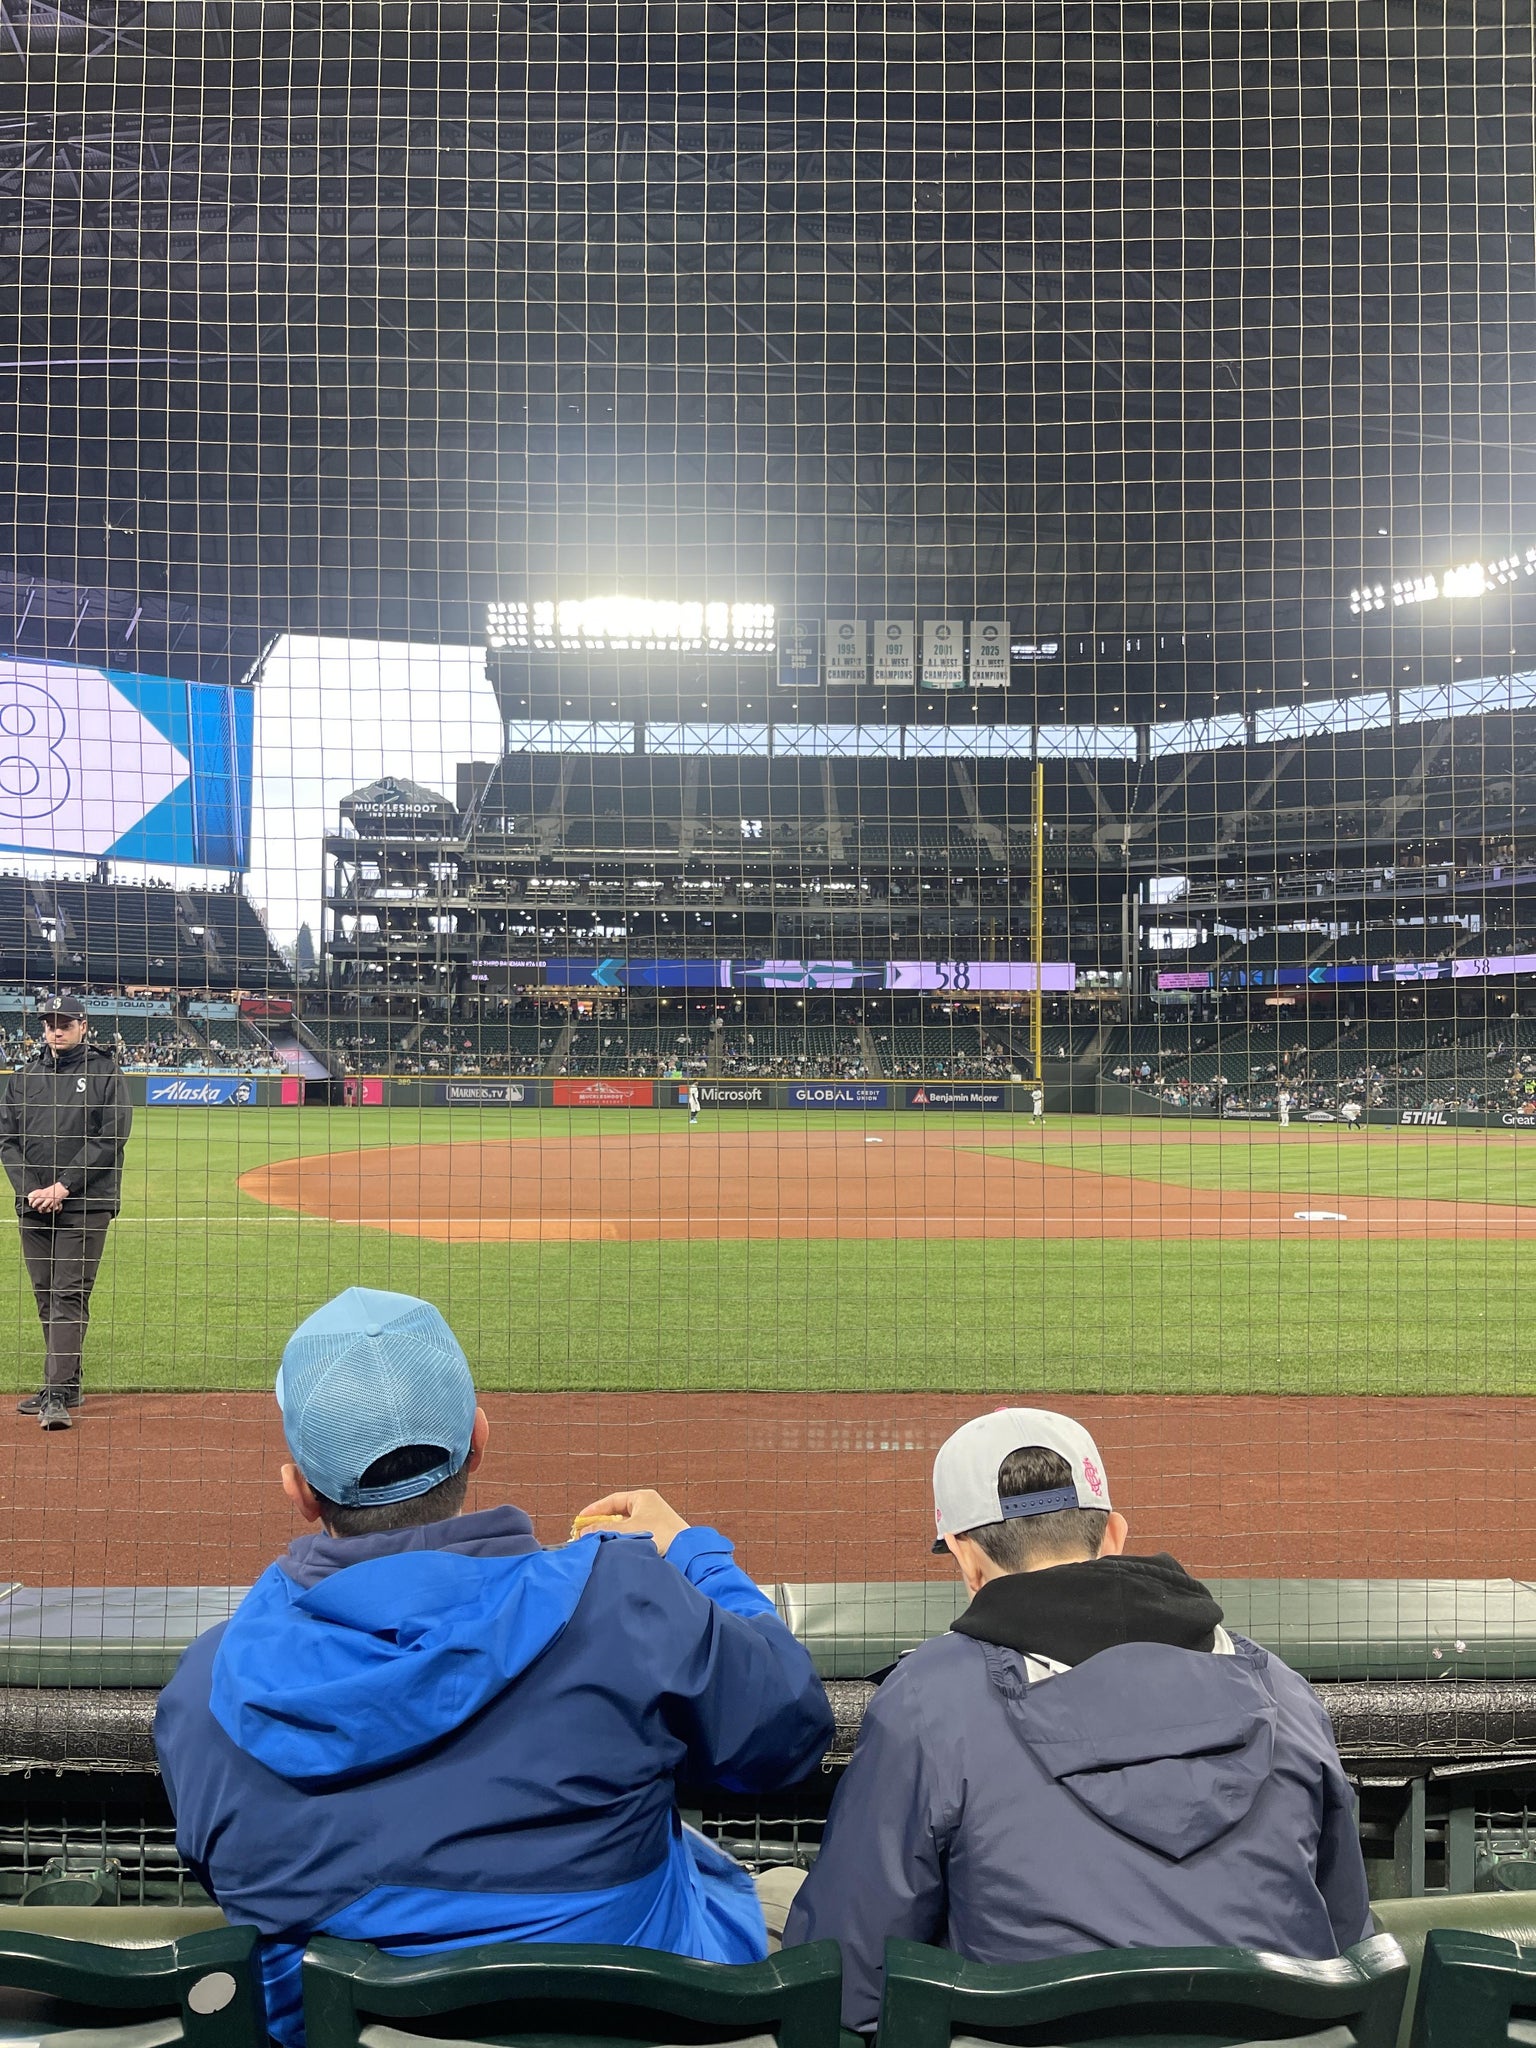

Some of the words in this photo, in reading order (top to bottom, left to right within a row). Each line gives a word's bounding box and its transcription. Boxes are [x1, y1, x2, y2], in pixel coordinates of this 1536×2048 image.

[838, 644, 856, 655] 1995
[886, 644, 903, 655] 1997
[934, 644, 953, 656] 2001
[980, 645, 1000, 656] 2025
[891, 658, 909, 667] WEST
[940, 658, 958, 667] WEST
[988, 659, 1004, 668] WEST
[828, 670, 865, 680] CHAMPIONS
[875, 670, 913, 680] CHAMPIONS
[924, 670, 962, 680] CHAMPIONS
[972, 671, 1008, 681] CHAMPIONS
[354, 803, 438, 813] MUCKLESHOOT
[499, 960, 525, 968] BAEMAN
[1473, 958, 1490, 975] 58
[935, 961, 971, 990] 58
[76, 1077, 87, 1093] S
[151, 1081, 222, 1103] Alaska
[701, 1087, 762, 1101] Microsoft
[796, 1089, 854, 1101] GLOBAL
[929, 1092, 969, 1104] Benjamin
[973, 1093, 999, 1103] Moore
[1400, 1111, 1447, 1125] STIHL
[1502, 1113, 1536, 1126] Great
